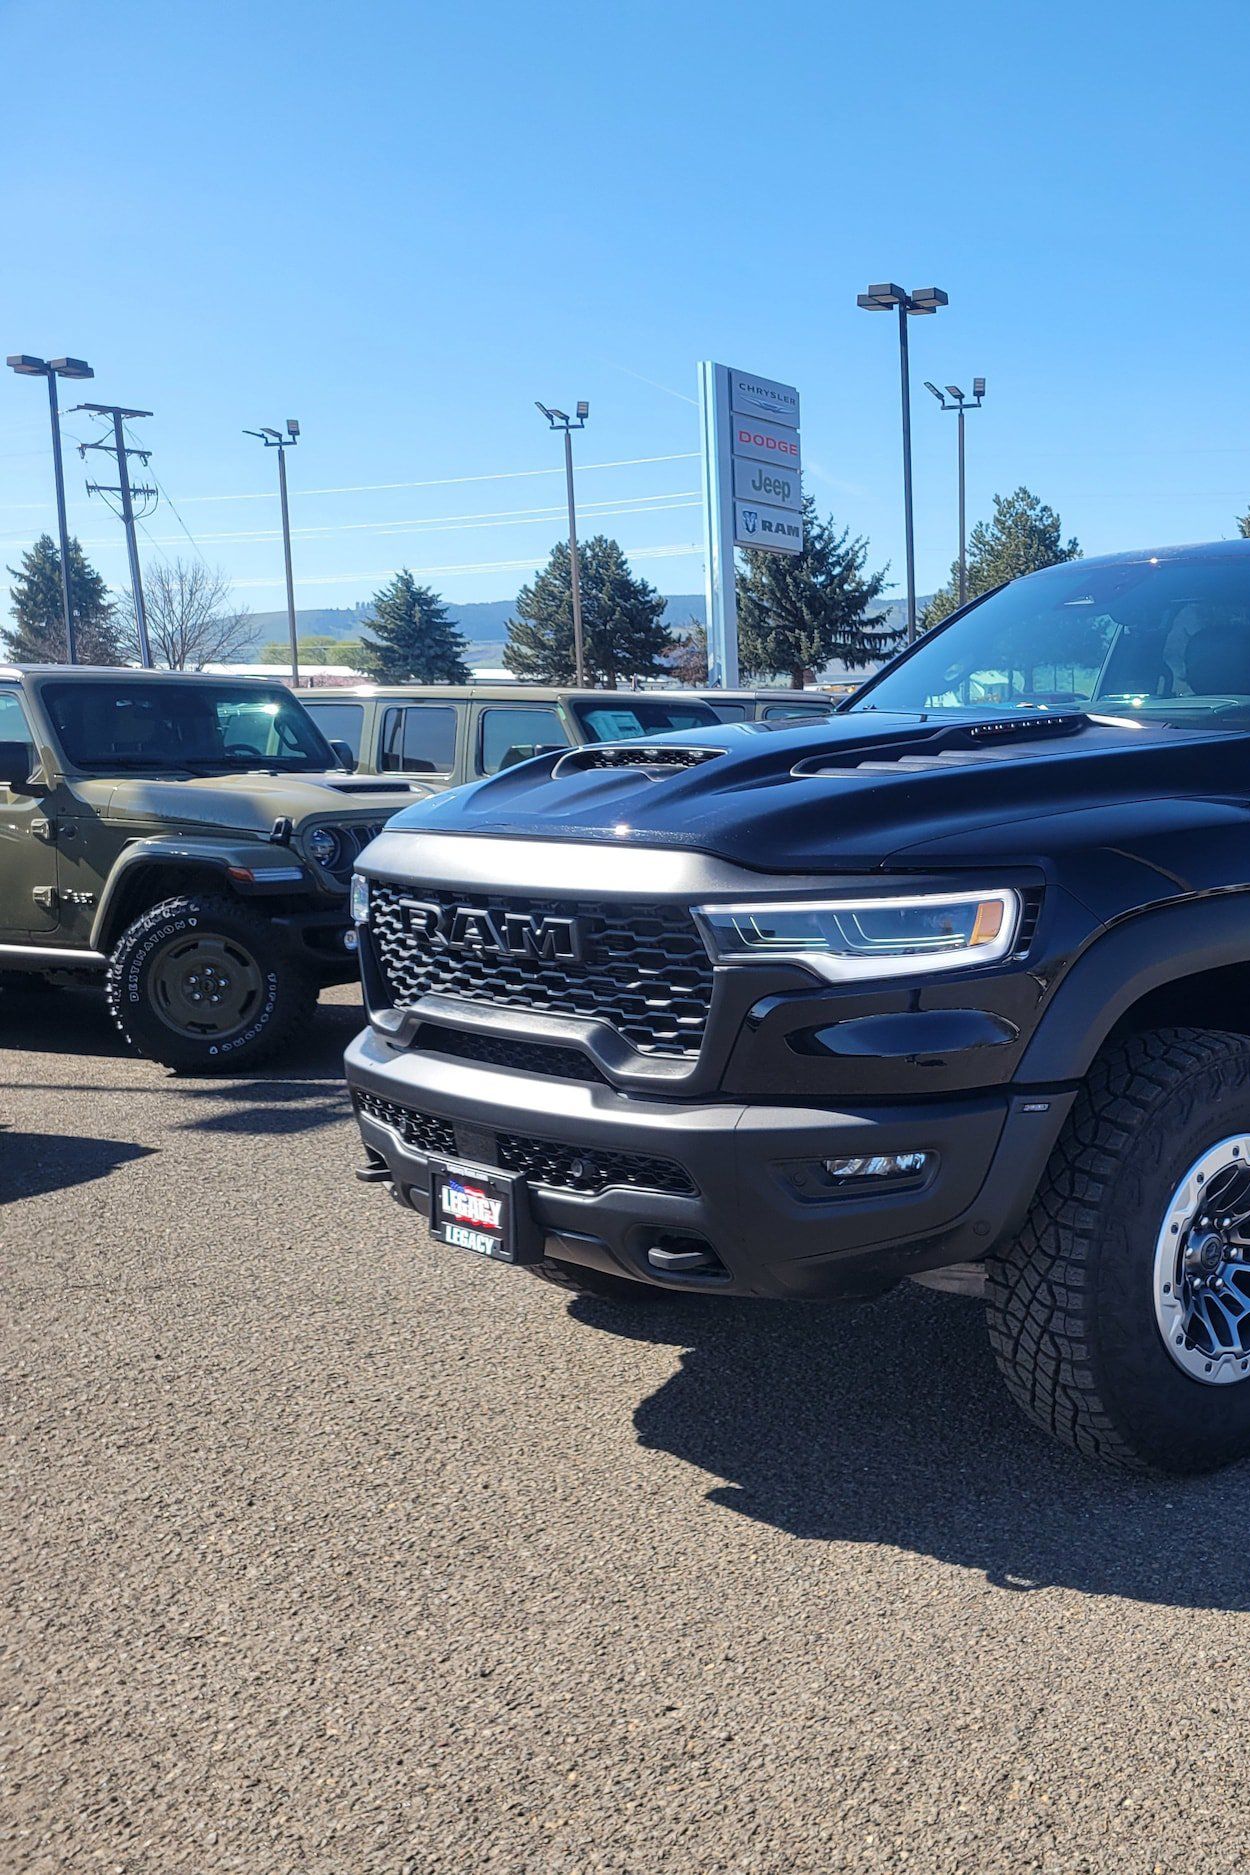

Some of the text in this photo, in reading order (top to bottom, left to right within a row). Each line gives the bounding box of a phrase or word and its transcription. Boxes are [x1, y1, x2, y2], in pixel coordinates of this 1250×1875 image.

[738, 382, 796, 406] CHRYSLER
[738, 430, 799, 456] DODGE
[751, 468, 791, 501] Jeep
[761, 519, 799, 538] RAM
[399, 899, 580, 961] RAM
[129, 919, 187, 1002] DESTINATION
[441, 1185, 502, 1226] LEGACY
[445, 1225, 495, 1255] LEGACY
